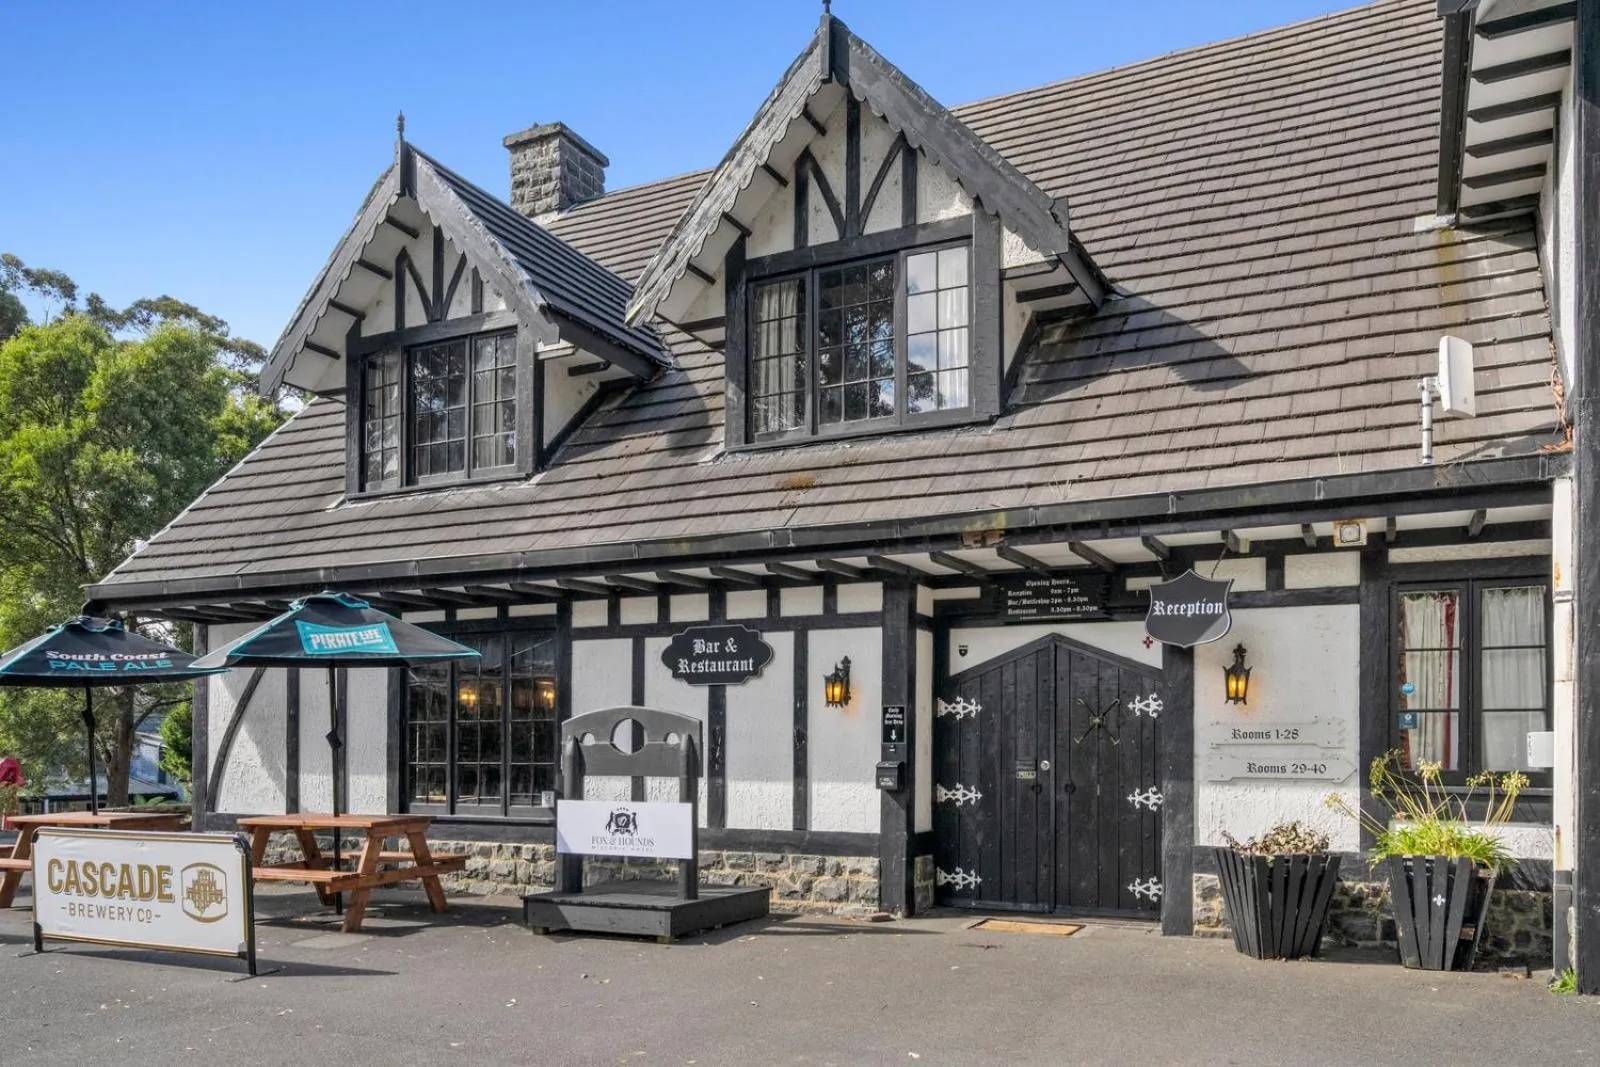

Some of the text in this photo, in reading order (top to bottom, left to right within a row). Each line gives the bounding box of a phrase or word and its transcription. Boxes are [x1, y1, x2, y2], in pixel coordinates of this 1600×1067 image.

[1152, 598, 1223, 617] Reception
[309, 631, 363, 649] PIRATE
[692, 637, 738, 656] Bar &
[46, 650, 169, 661] South Coast
[48, 660, 173, 671] PALE ALE
[677, 657, 754, 673] Restaurant
[1231, 728, 1300, 740] Rooms 1-28
[1246, 762, 1327, 774] Rooms 29-40
[591, 836, 657, 847] FOX & HOUNDS
[47, 858, 175, 903] CASCADE
[68, 903, 132, 922] BREWERY
